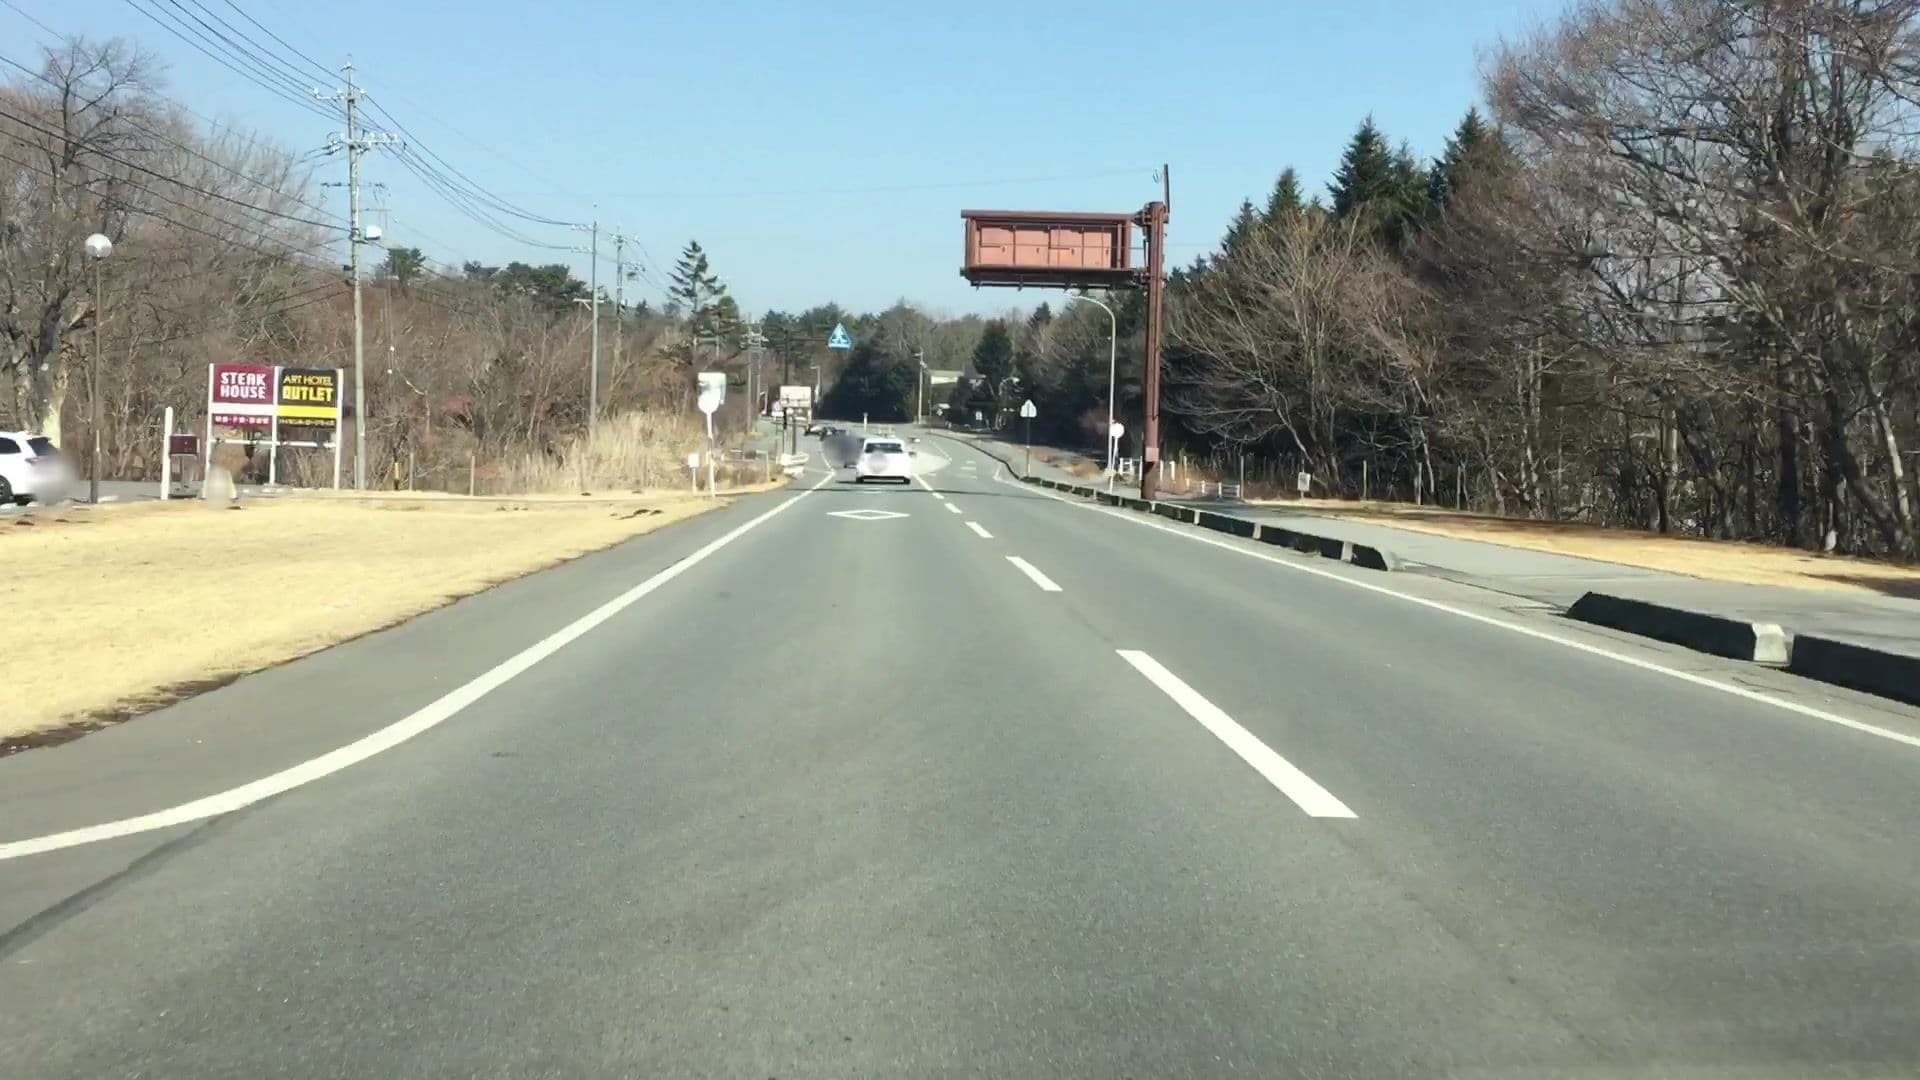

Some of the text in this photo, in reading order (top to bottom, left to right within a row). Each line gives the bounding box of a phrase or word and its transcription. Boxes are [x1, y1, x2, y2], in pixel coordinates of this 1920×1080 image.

[220, 372, 266, 386] STEAK
[283, 375, 333, 386] ART HOTEL
[220, 385, 266, 399] HOUSE
[282, 386, 334, 402] OUTLET
